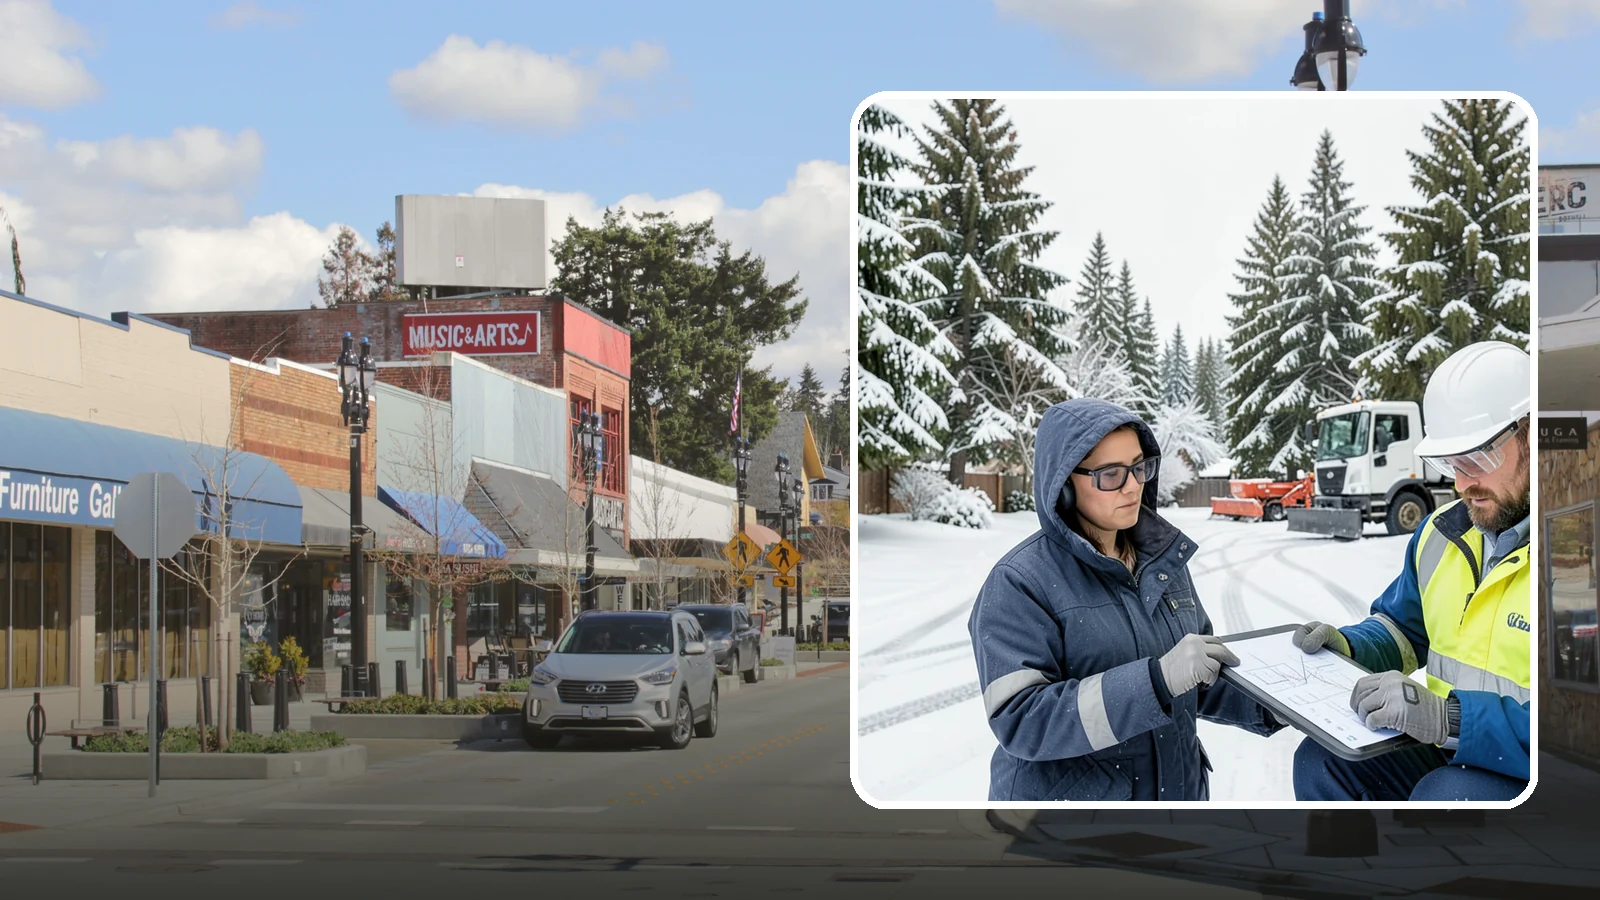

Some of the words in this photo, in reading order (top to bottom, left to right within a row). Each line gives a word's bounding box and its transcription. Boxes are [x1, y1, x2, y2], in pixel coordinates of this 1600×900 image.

[1540, 427, 1578, 436] UGA
[0, 471, 79, 515] Furniture
[90, 482, 122, 519] Gal
[453, 563, 479, 574] SUSHI
